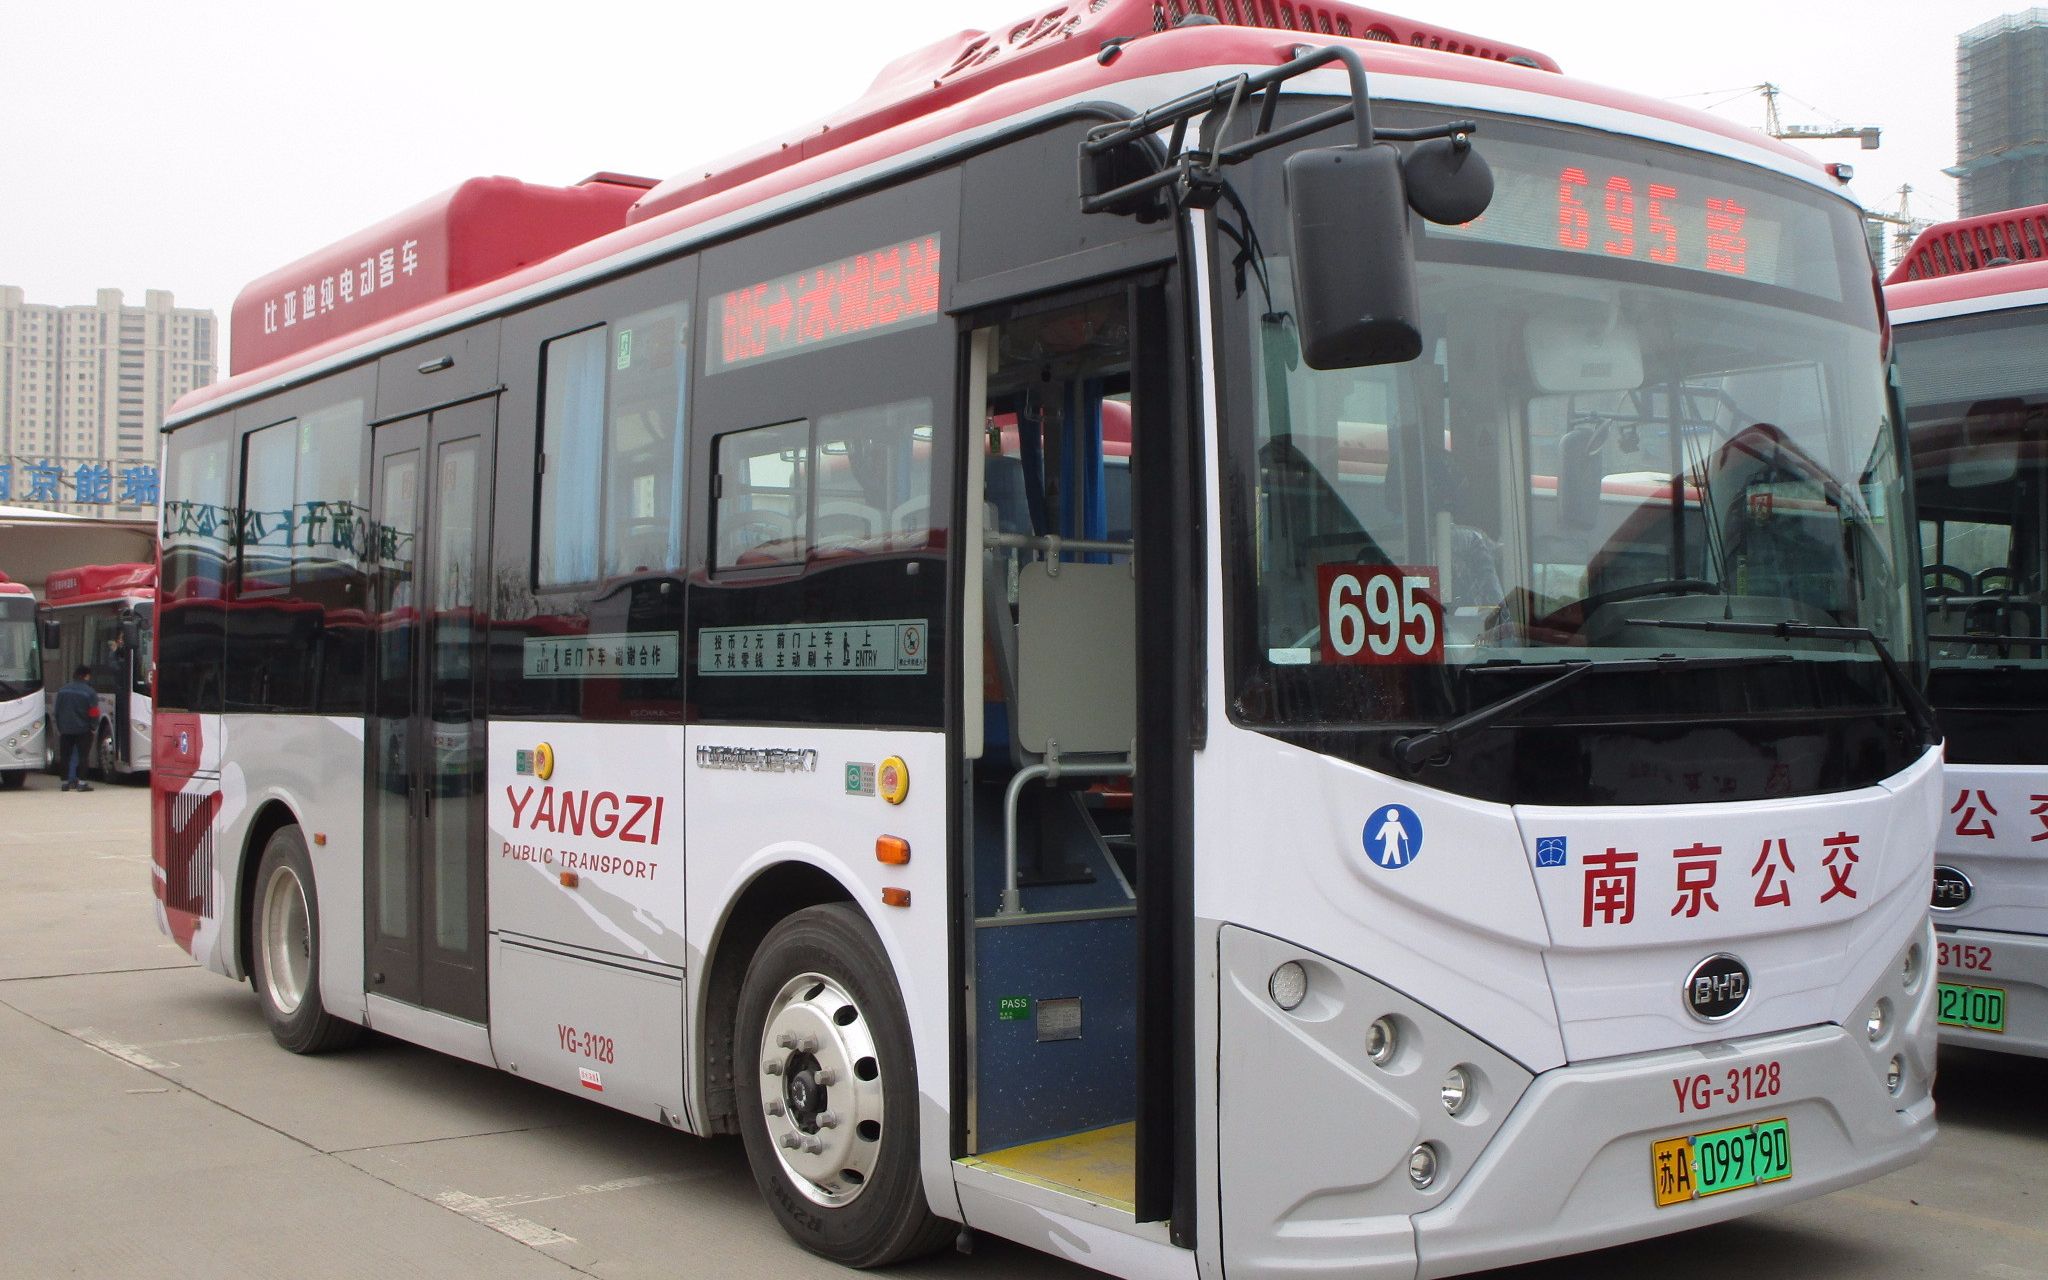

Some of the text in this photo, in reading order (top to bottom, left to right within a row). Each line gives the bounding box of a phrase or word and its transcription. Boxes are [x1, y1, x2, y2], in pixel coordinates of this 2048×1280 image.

[265, 240, 417, 335] 比亚迪纯电动客车
[1328, 573, 1436, 657] 695
[564, 647, 607, 667] 后门下车
[714, 633, 764, 650] 投币2元
[776, 630, 834, 649] 前门上车
[714, 651, 764, 669] 不找零钱
[776, 649, 833, 669] 主动刷卡
[855, 649, 878, 669] ENTRY
[506, 784, 664, 846] YANGZI
[502, 842, 658, 881] PUBLIC TRANSPORT
[1582, 831, 1860, 928] 南京公交
[1001, 998, 1027, 1009] PASS
[1694, 971, 1745, 1005] BYD
[557, 1023, 614, 1065] YG-3128
[1672, 1061, 1781, 1113] YG-3128
